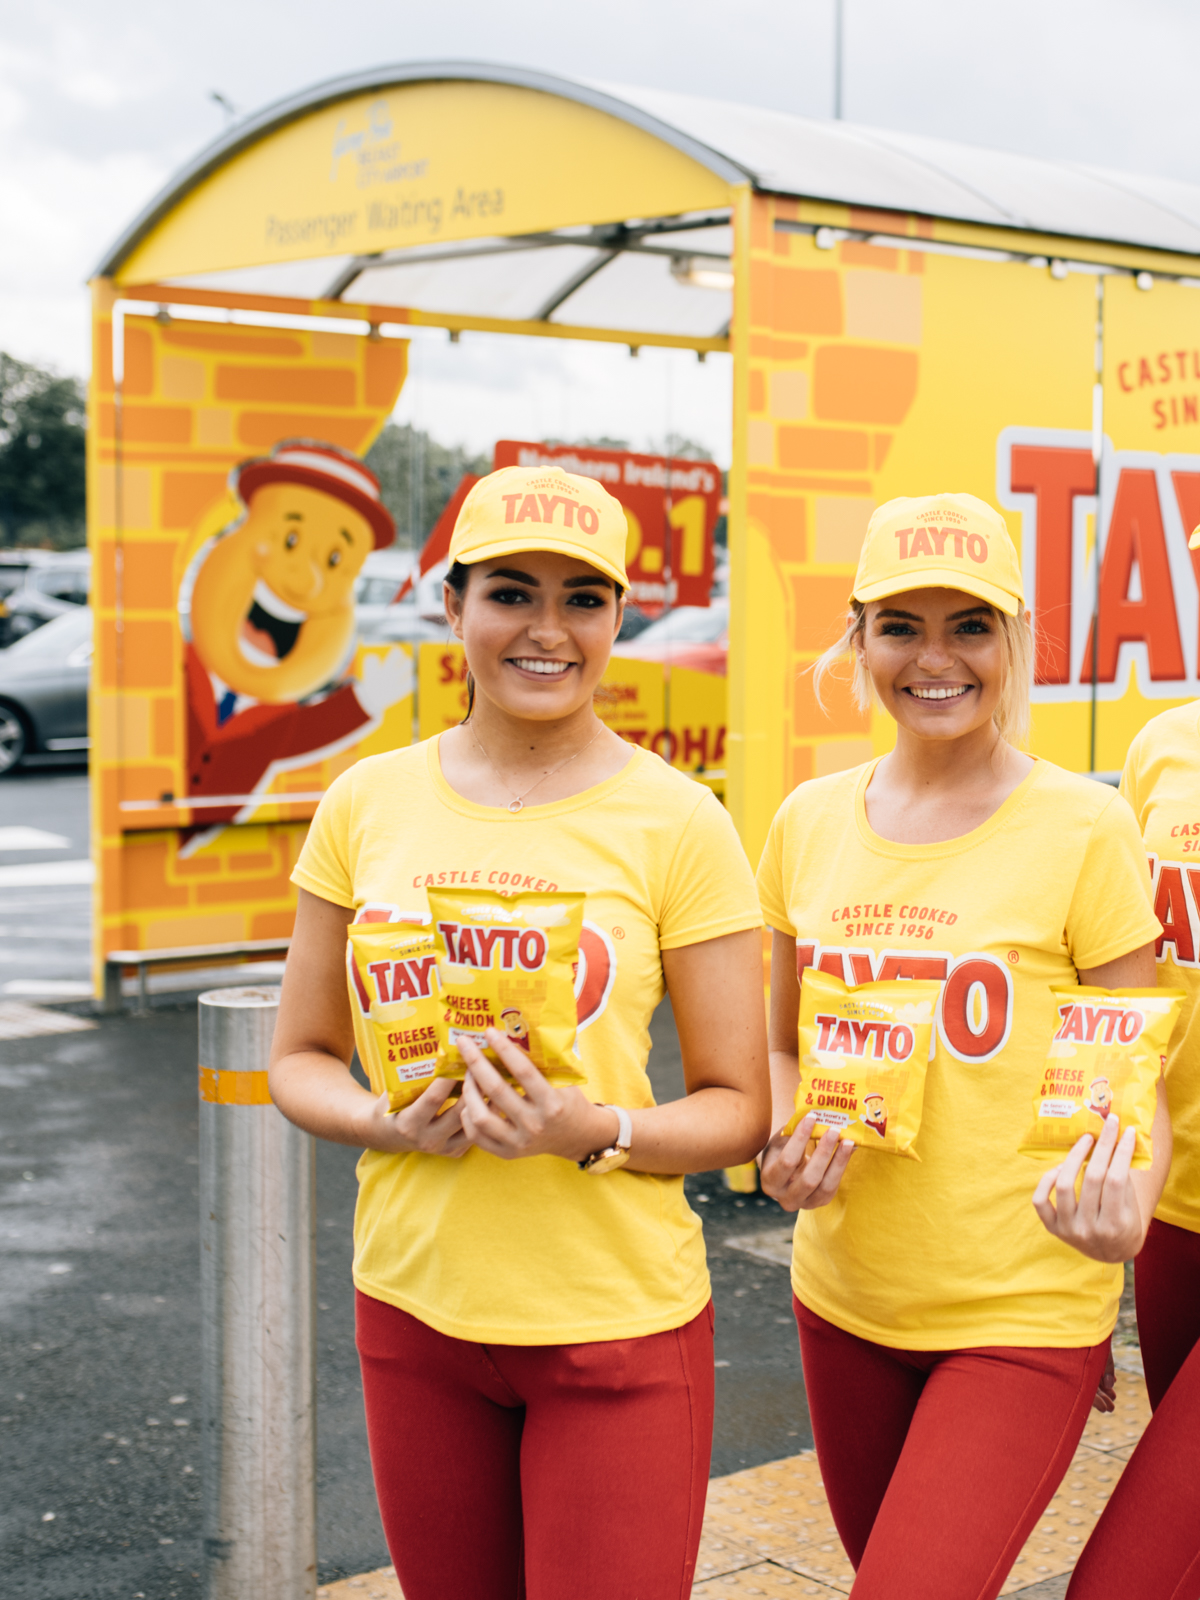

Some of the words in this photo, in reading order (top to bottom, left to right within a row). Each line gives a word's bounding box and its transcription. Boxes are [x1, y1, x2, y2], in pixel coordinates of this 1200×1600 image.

[265, 211, 357, 247] Passenger
[367, 191, 443, 234] Waiting
[452, 185, 504, 220] Area
[526, 477, 553, 487] CASTLE
[554, 478, 580, 494] COOKED
[624, 460, 716, 494] Ireland's
[533, 483, 555, 491] SINCE
[502, 492, 600, 536] TAYTO
[916, 510, 941, 520] CASTLE
[942, 510, 968, 523] COOKED
[894, 526, 989, 564] TAYTO
[412, 870, 481, 888] CASTLE
[487, 870, 559, 893] COOKED
[831, 904, 893, 922] CASTLE
[898, 904, 958, 926] COOKED
[844, 922, 895, 938] SINCE
[899, 923, 934, 940] 1956
[438, 923, 546, 970] TAYTO
[369, 956, 438, 1004] TAY
[446, 994, 490, 1012] CHEESE
[839, 1001, 864, 1010] CASTLE
[443, 1008, 452, 1022] &
[454, 1011, 495, 1028] ONION
[387, 1026, 436, 1046] CHEESE
[816, 1015, 914, 1061] TAYTO
[387, 1049, 397, 1062] &
[1044, 1068, 1085, 1082] CHEESE
[811, 1077, 856, 1096] CHEESE
[1040, 1083, 1047, 1096] &
[1049, 1083, 1085, 1097] ONION
[804, 1092, 813, 1106] &
[817, 1094, 858, 1111] ONION
